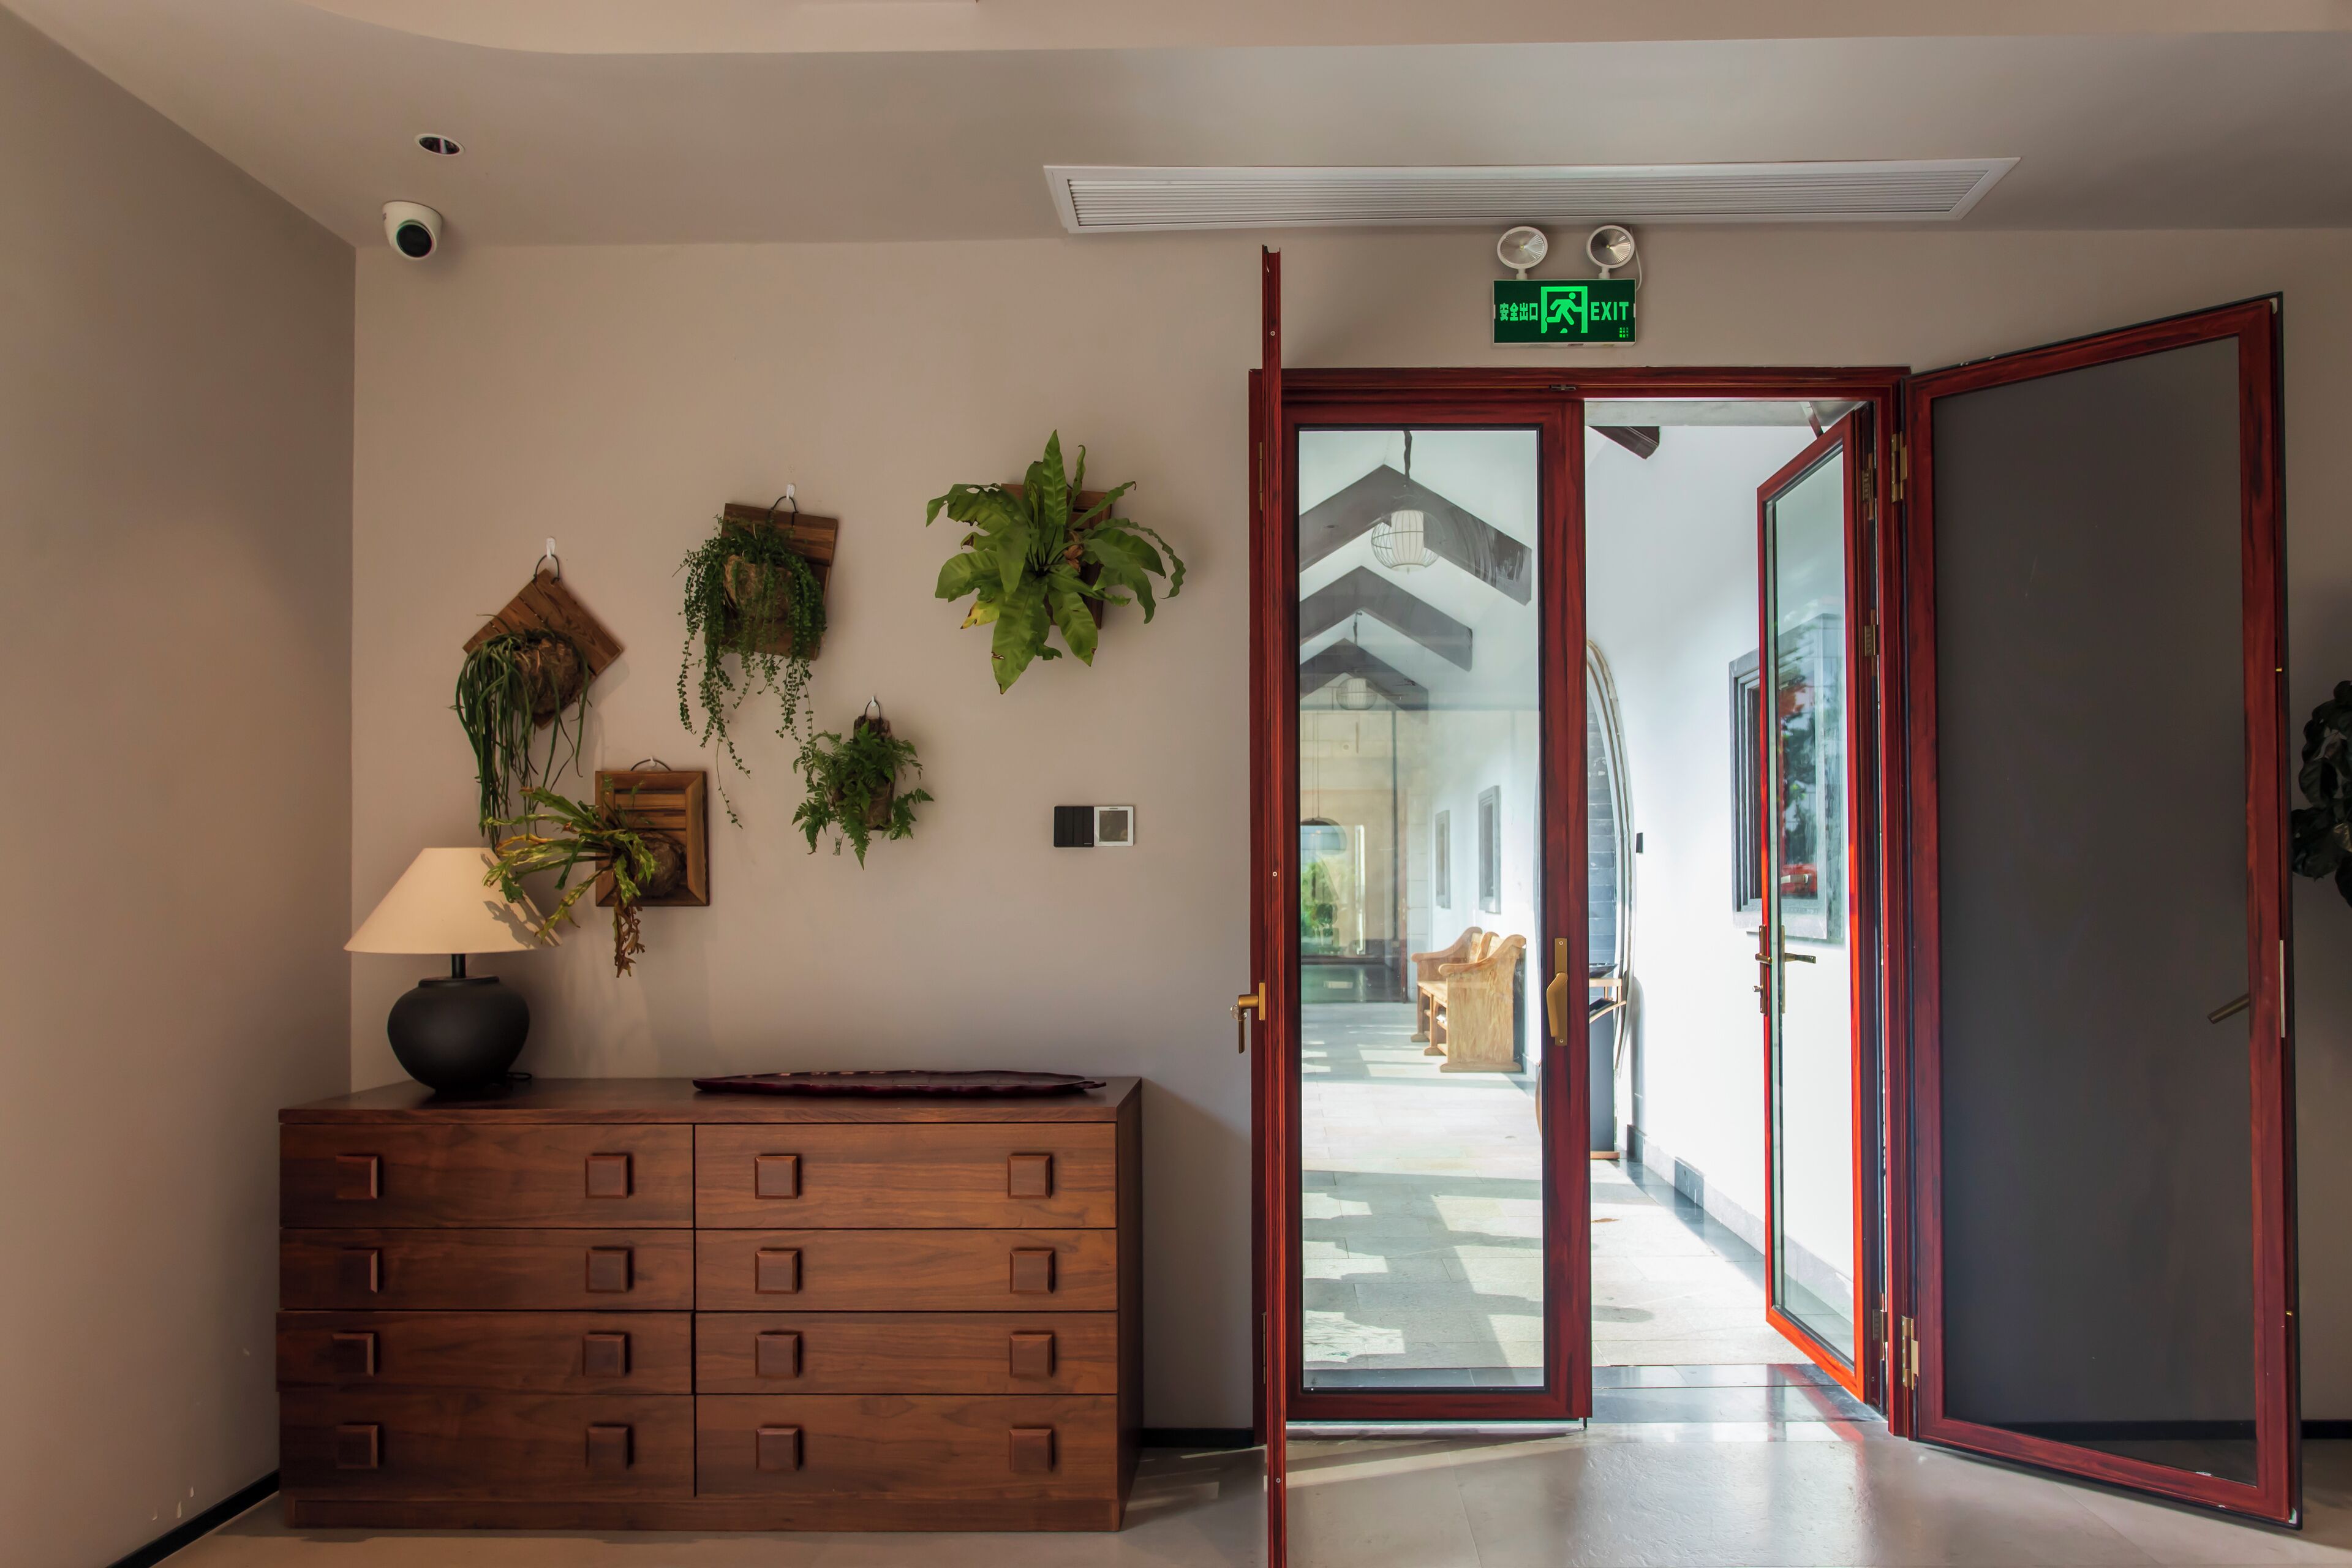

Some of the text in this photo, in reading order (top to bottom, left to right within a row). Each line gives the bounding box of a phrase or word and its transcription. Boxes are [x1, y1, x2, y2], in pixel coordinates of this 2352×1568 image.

[1499, 303, 1538, 321] 安全出口
[1591, 301, 1629, 320] EXIT
